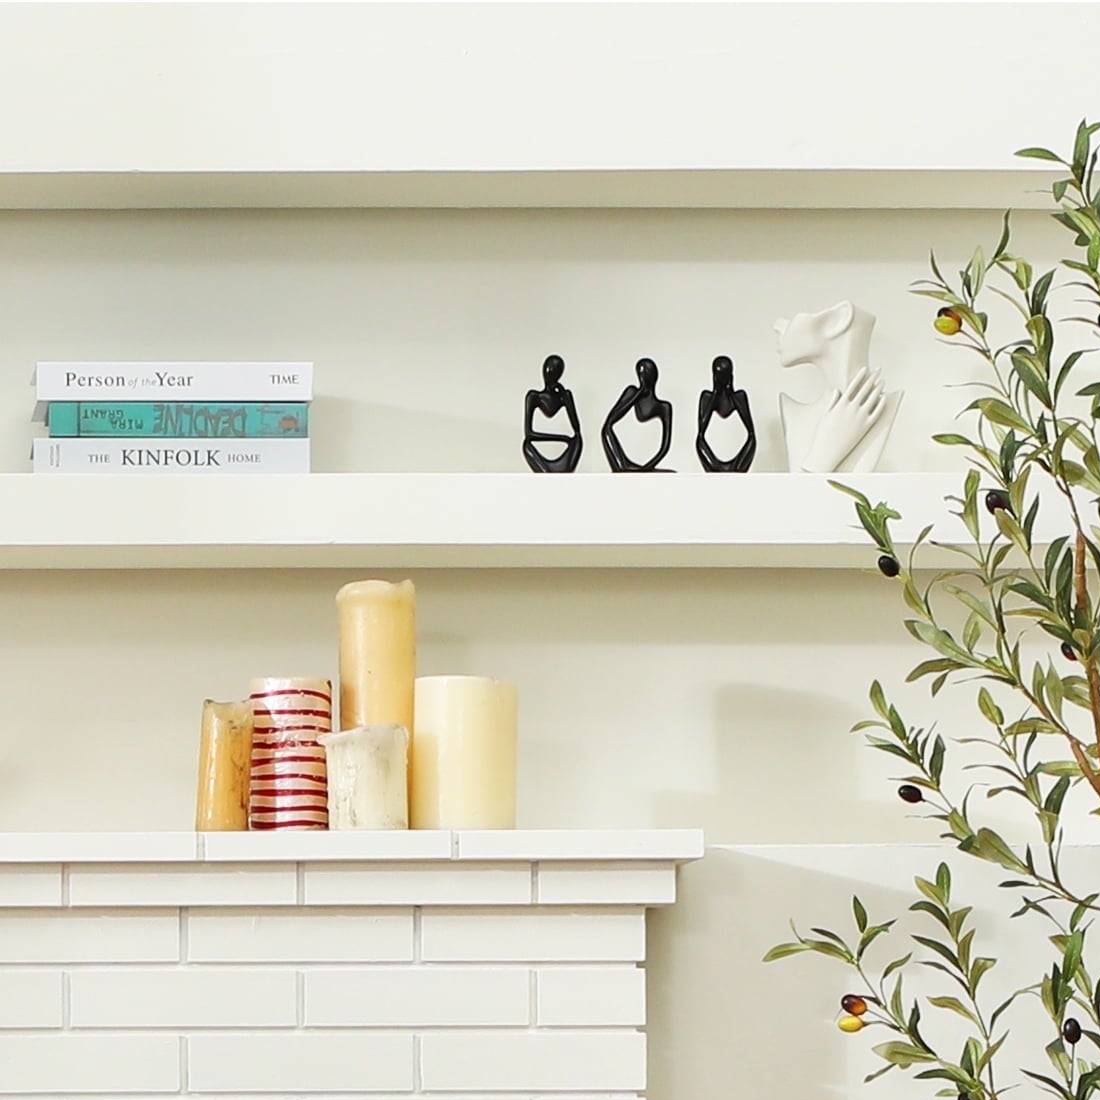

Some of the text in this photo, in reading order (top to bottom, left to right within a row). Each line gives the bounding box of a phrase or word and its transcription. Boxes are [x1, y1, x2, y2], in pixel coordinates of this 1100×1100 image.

[65, 372, 194, 389] Person of the Year
[270, 374, 300, 385] TIME
[82, 408, 124, 418] GRANT
[152, 402, 248, 436] DEADLINE
[110, 419, 144, 429] MIRA
[88, 449, 261, 466] THE KINFOLK HOME
